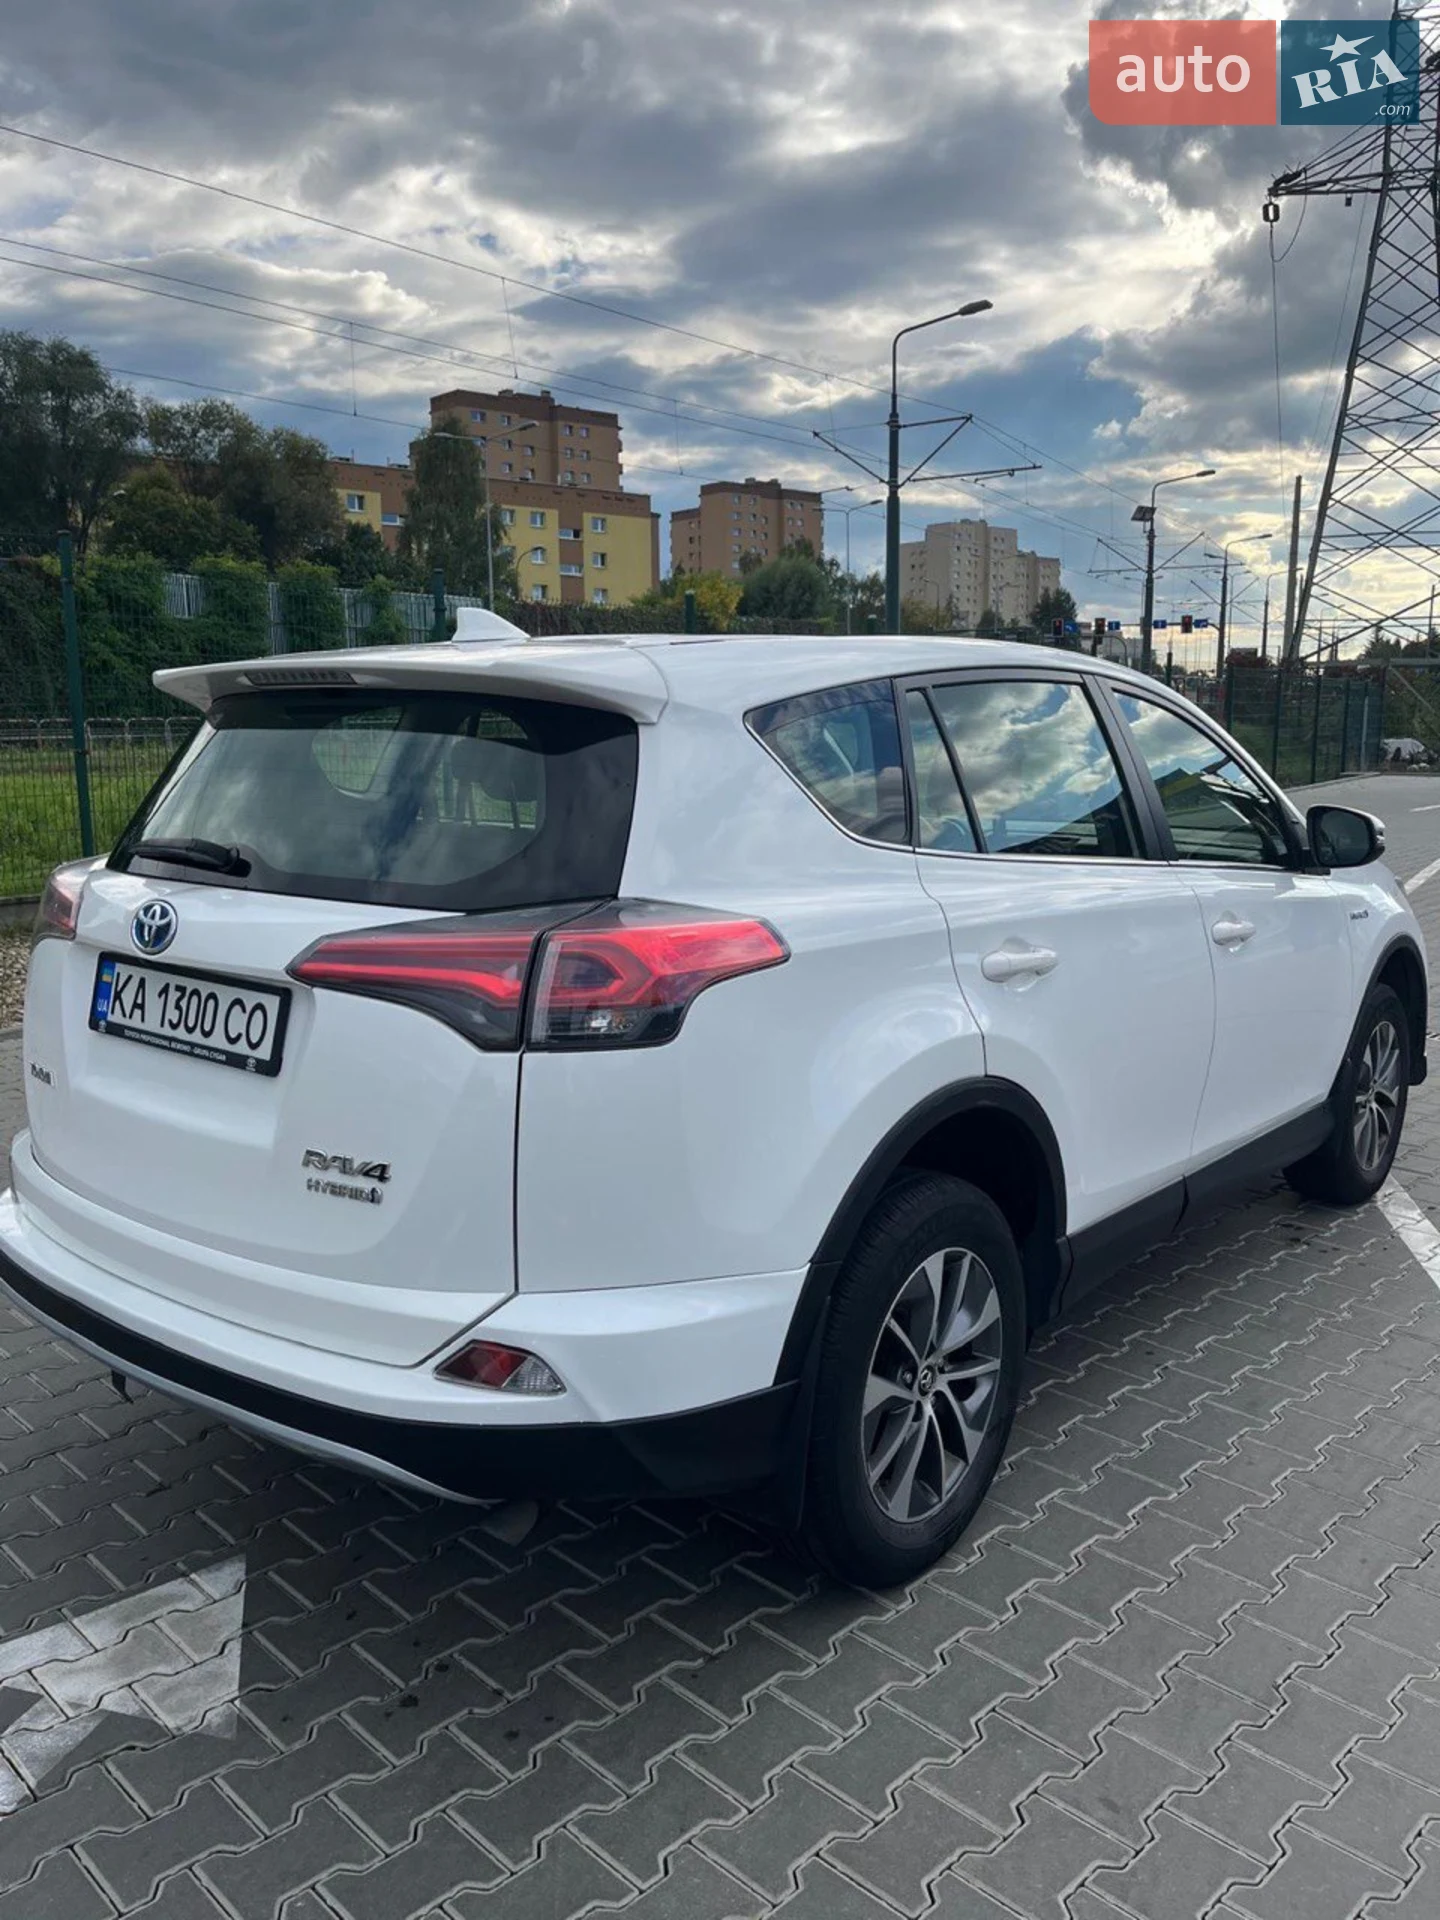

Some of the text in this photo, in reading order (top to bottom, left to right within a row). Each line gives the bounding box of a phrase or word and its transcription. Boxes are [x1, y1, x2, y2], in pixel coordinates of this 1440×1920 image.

[110, 971, 147, 1024] KA
[157, 982, 220, 1039] 1300
[223, 996, 268, 1051] CO
[301, 1147, 392, 1184] RAV4
